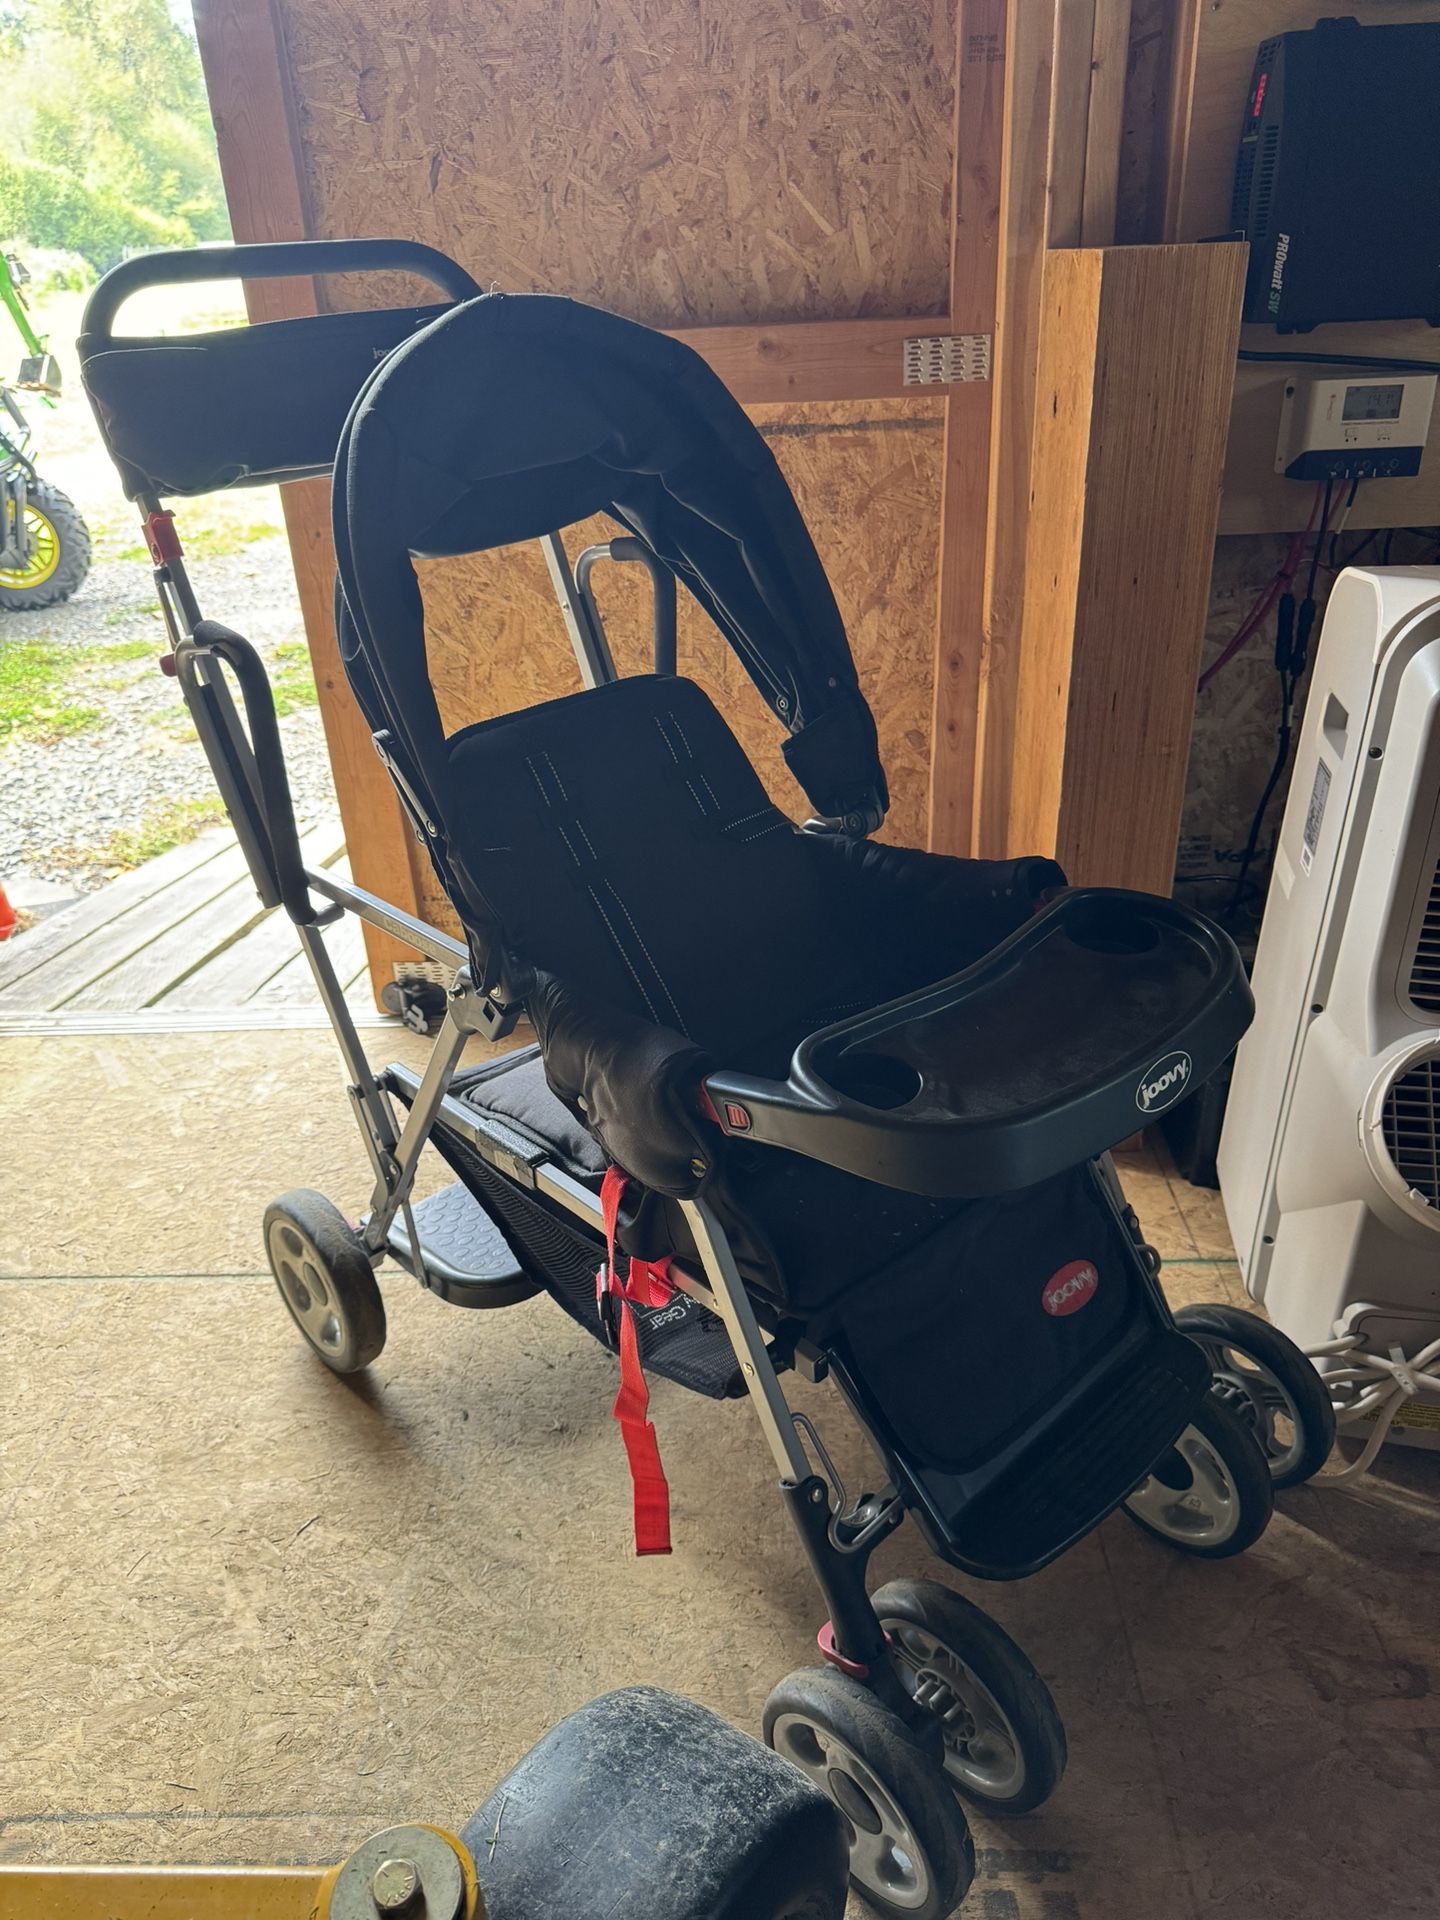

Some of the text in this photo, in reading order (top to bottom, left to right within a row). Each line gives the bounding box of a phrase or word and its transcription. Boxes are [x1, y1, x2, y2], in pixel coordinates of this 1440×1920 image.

[1268, 233, 1290, 314] PROwatt SW
[1141, 1058, 1188, 1109] joovy
[1045, 1267, 1094, 1314] joovy
[650, 1306, 686, 1330] Gear
